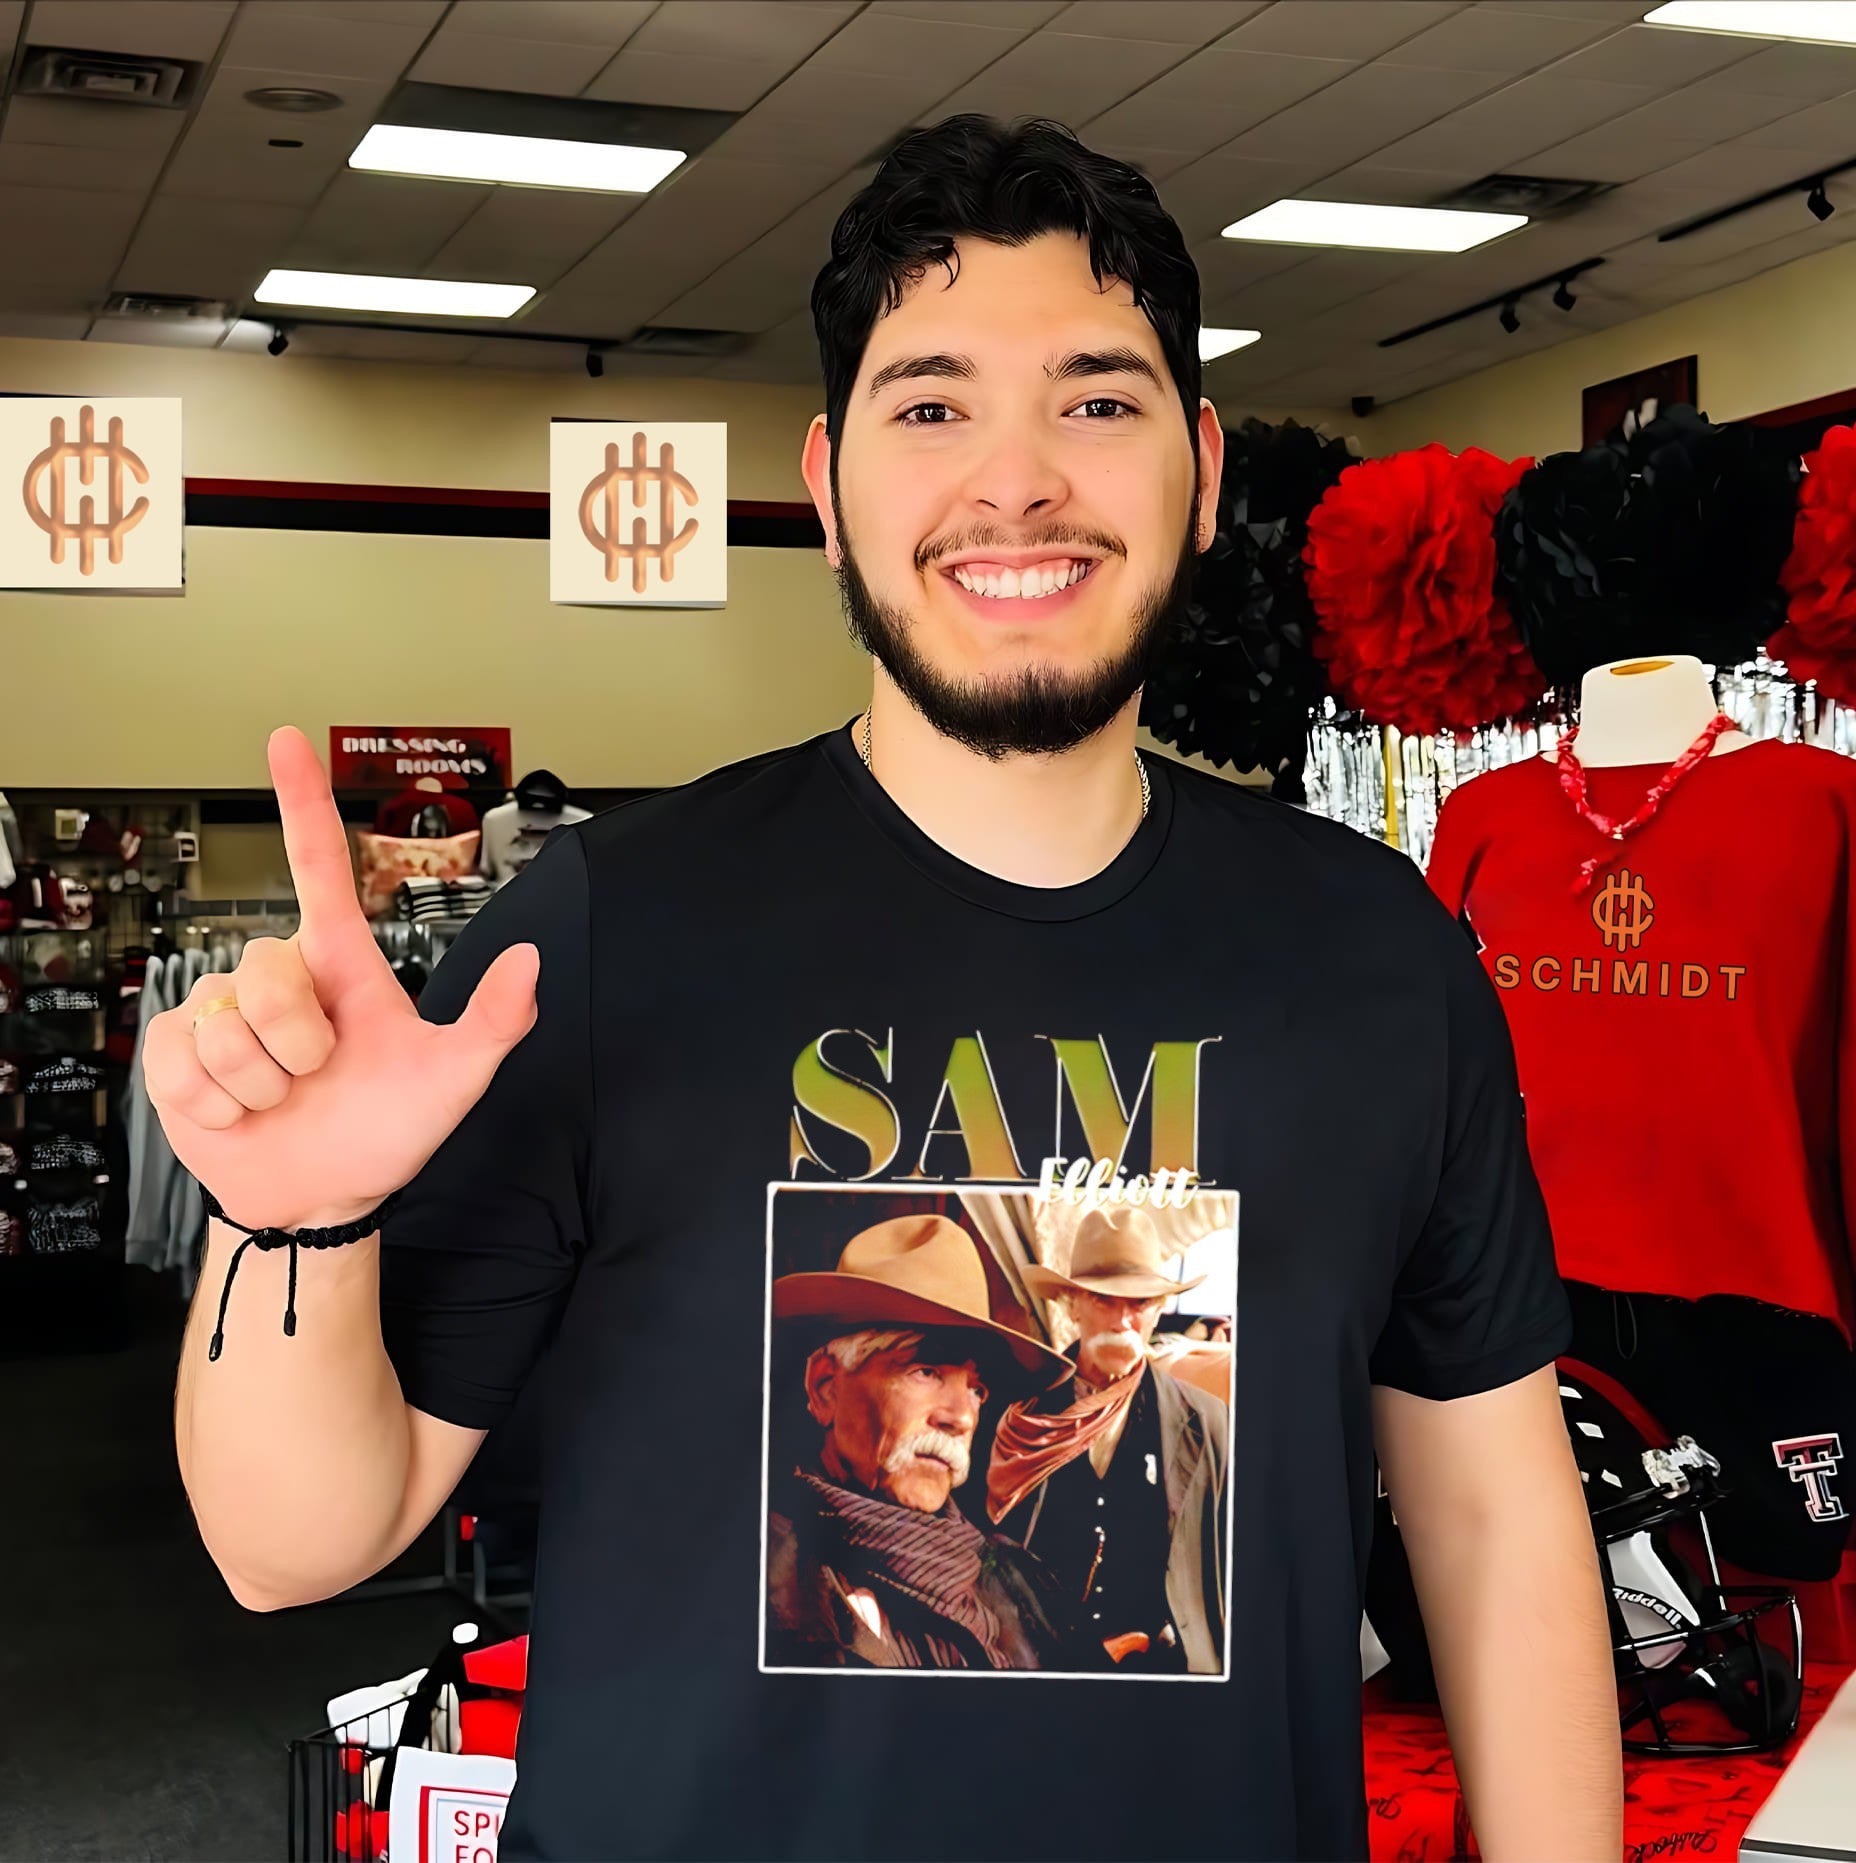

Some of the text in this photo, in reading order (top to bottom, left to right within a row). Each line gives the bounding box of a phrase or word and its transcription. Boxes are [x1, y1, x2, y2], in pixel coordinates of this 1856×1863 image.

[342, 737, 467, 754] DRESSING
[396, 759, 487, 775] ROOMS
[1494, 954, 1746, 1000] SCHMIDT
[790, 1027, 1222, 1185] SAM
[1038, 1157, 1198, 1210] Elliott
